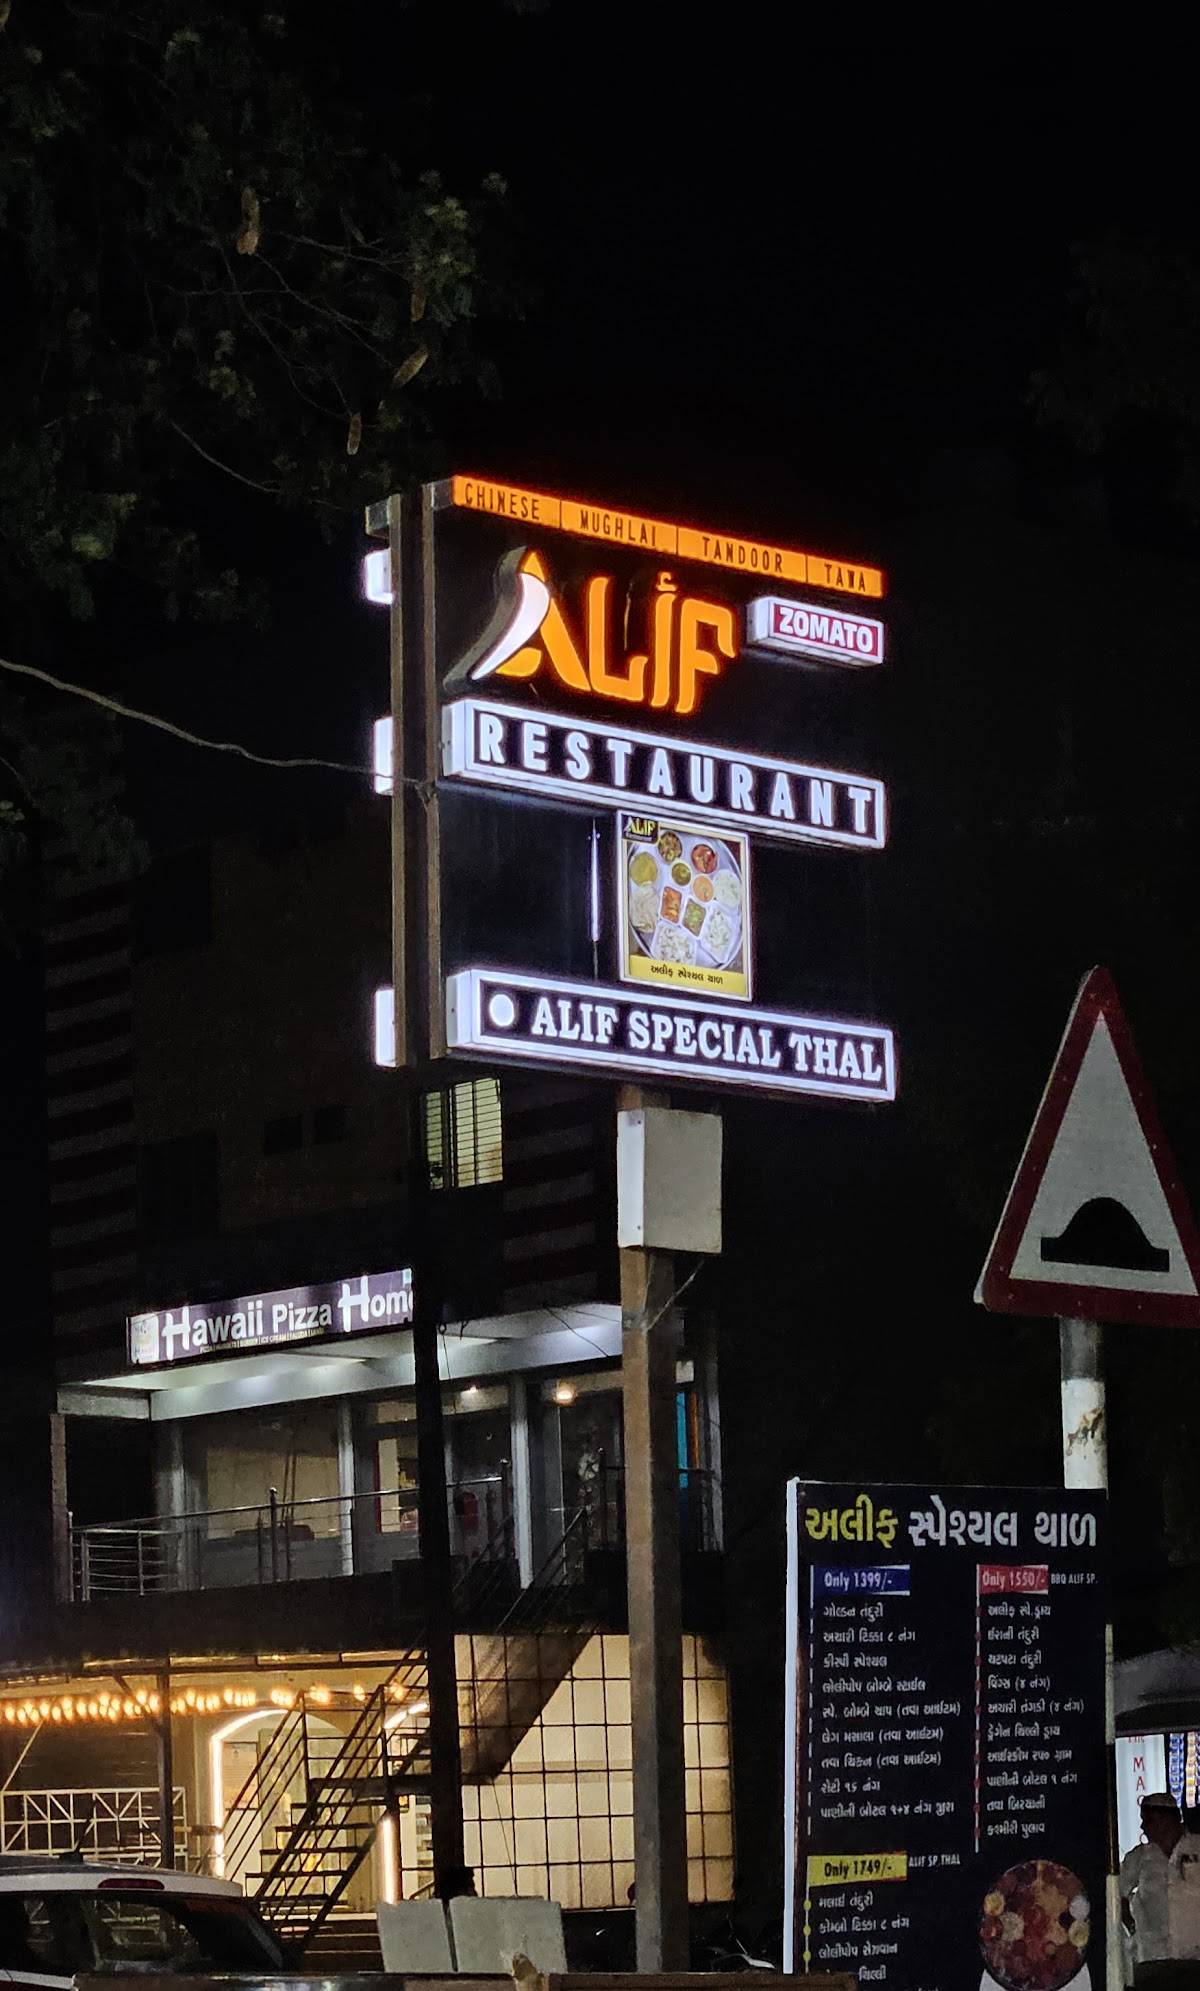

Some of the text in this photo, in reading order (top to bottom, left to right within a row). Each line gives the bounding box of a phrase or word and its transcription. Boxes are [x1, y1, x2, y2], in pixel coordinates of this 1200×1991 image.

[464, 482, 540, 521] CHINESE
[580, 510, 657, 547] MUGHLAI
[702, 536, 784, 573] TANDOOR
[823, 563, 867, 593] TAWA
[780, 606, 873, 653] ZOMATO
[479, 713, 874, 834] RESTAURANT
[624, 816, 656, 836] ALIF
[651, 963, 673, 978] અલીફ
[531, 997, 883, 1082] ALIF SPECIAL THAL
[161, 1300, 263, 1361] Hawaii
[271, 1303, 333, 1334] Pizza
[805, 1493, 1096, 1549] અલીફ સ્પેશ્યલ થાળ
[824, 1571, 893, 1592] Only 1399/-
[982, 1571, 1046, 1592] Only 1550/-
[1051, 1573, 1066, 1584] BBQ
[1068, 1573, 1085, 1584] ALIF
[823, 1602, 884, 1622] ગોલ્ડન તંદુરી
[988, 1601, 1015, 1618] અલીફ
[823, 1628, 854, 1643] અચારી
[898, 1627, 916, 1642] નંગ
[988, 1654, 1016, 1665] ચટપટા
[822, 1678, 862, 1693] લોલીપોપ
[866, 1677, 892, 1692] બોમ્બે
[844, 1702, 870, 1718] બોમ્બે
[874, 1706, 893, 1716] ચાપ
[988, 1698, 1016, 1713] અચારી
[1020, 1698, 1046, 1713] તંગડી
[822, 1728, 840, 1743] લેગ
[844, 1731, 874, 1743] મસાલા
[821, 1756, 840, 1768] તવા
[844, 1752, 872, 1768] ચિકન
[821, 1778, 840, 1793] રોટી
[862, 1777, 881, 1792] નંગ
[987, 1771, 1019, 1786] પાણીની
[1022, 1770, 1047, 1785] બોટલ
[1061, 1770, 1078, 1784] નંગ
[820, 1802, 855, 1818] પાણીની
[859, 1801, 886, 1816] બોટલ
[914, 1800, 932, 1814] નંગ
[987, 1800, 1004, 1811] તવા
[1021, 1822, 1046, 1839] પુલાવ
[909, 1855, 925, 1867] ALIF
[940, 1854, 961, 1866] THAL
[824, 1859, 893, 1880] Only 1749/-
[891, 1914, 910, 1929] નંગ
[819, 1942, 858, 1958] લોલીપોપ
